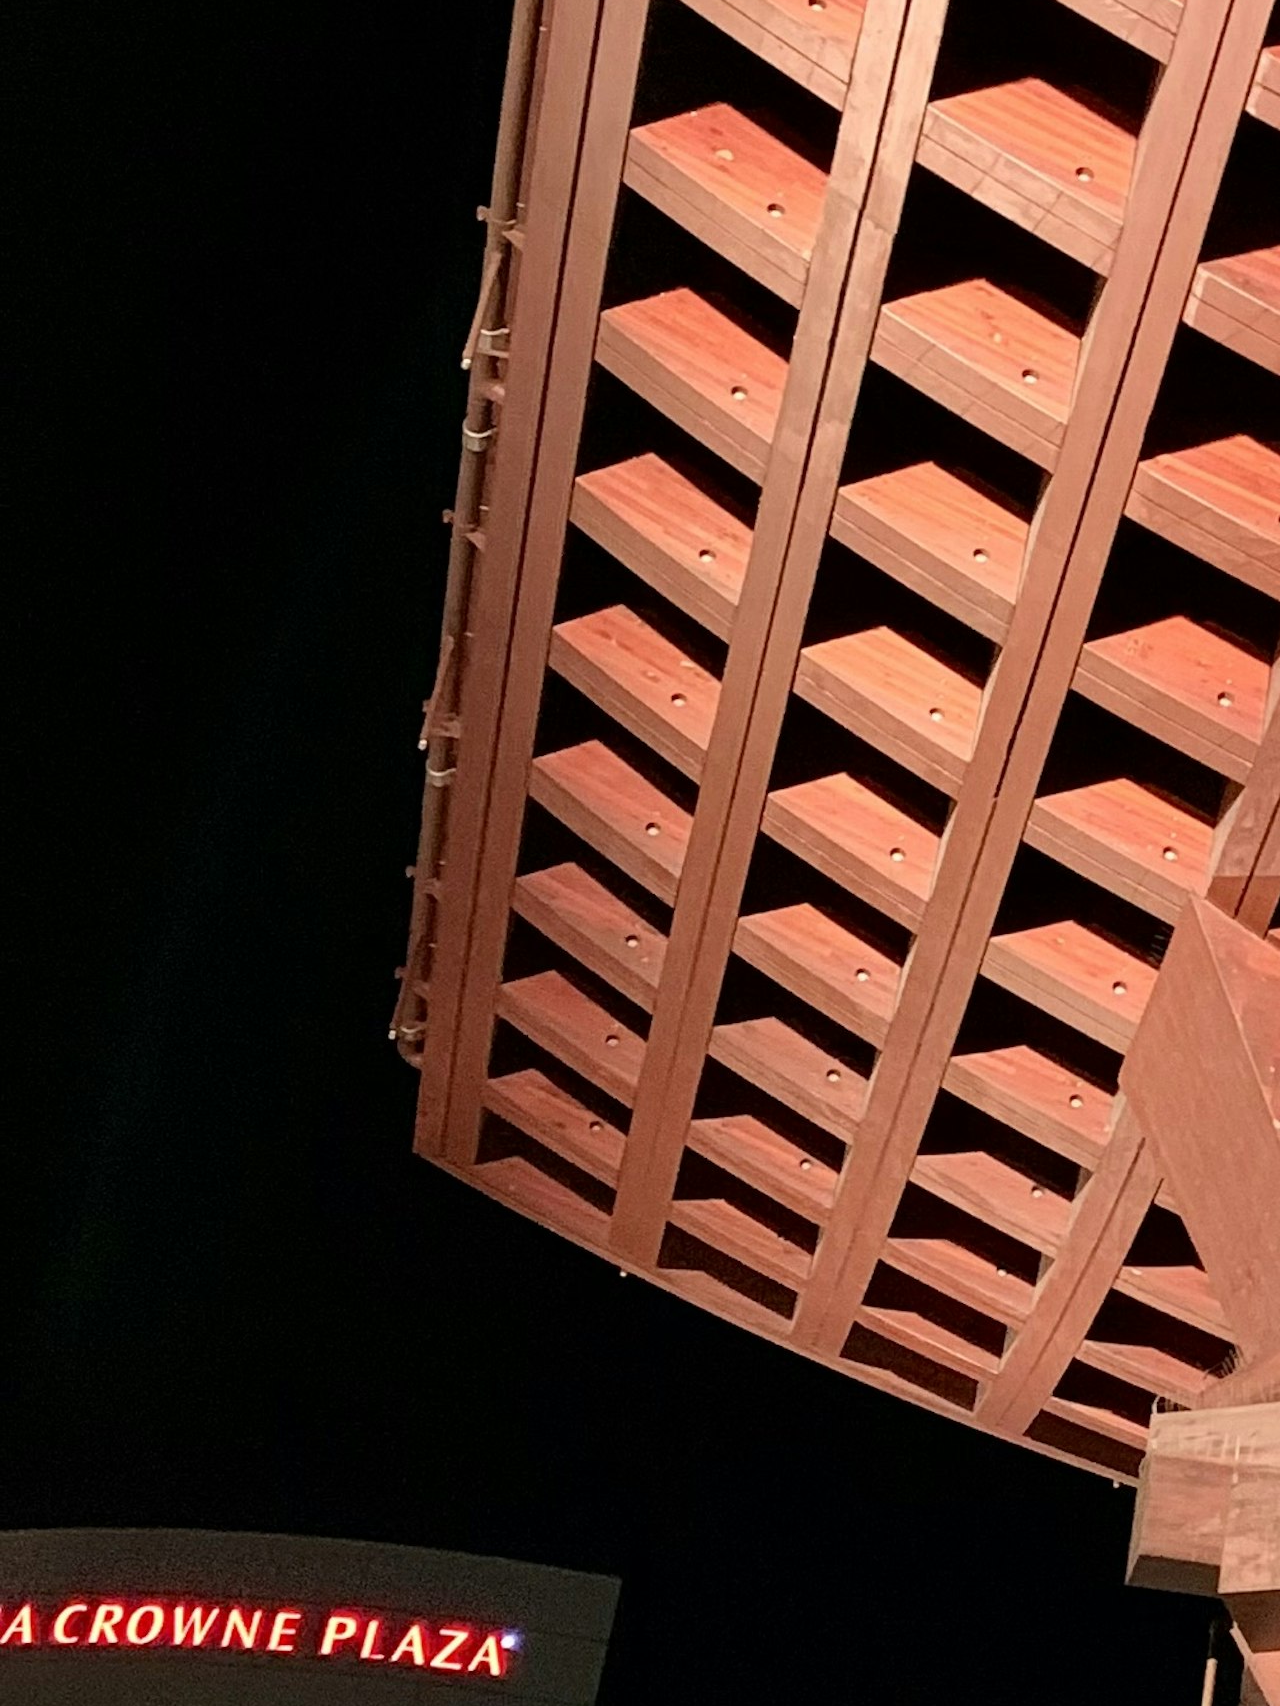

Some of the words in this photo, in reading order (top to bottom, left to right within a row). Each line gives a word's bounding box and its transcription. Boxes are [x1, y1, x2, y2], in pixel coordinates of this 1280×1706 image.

[0, 1604, 32, 1644] A
[54, 1603, 301, 1652] CROWNE
[320, 1616, 501, 1677] PLAZA
